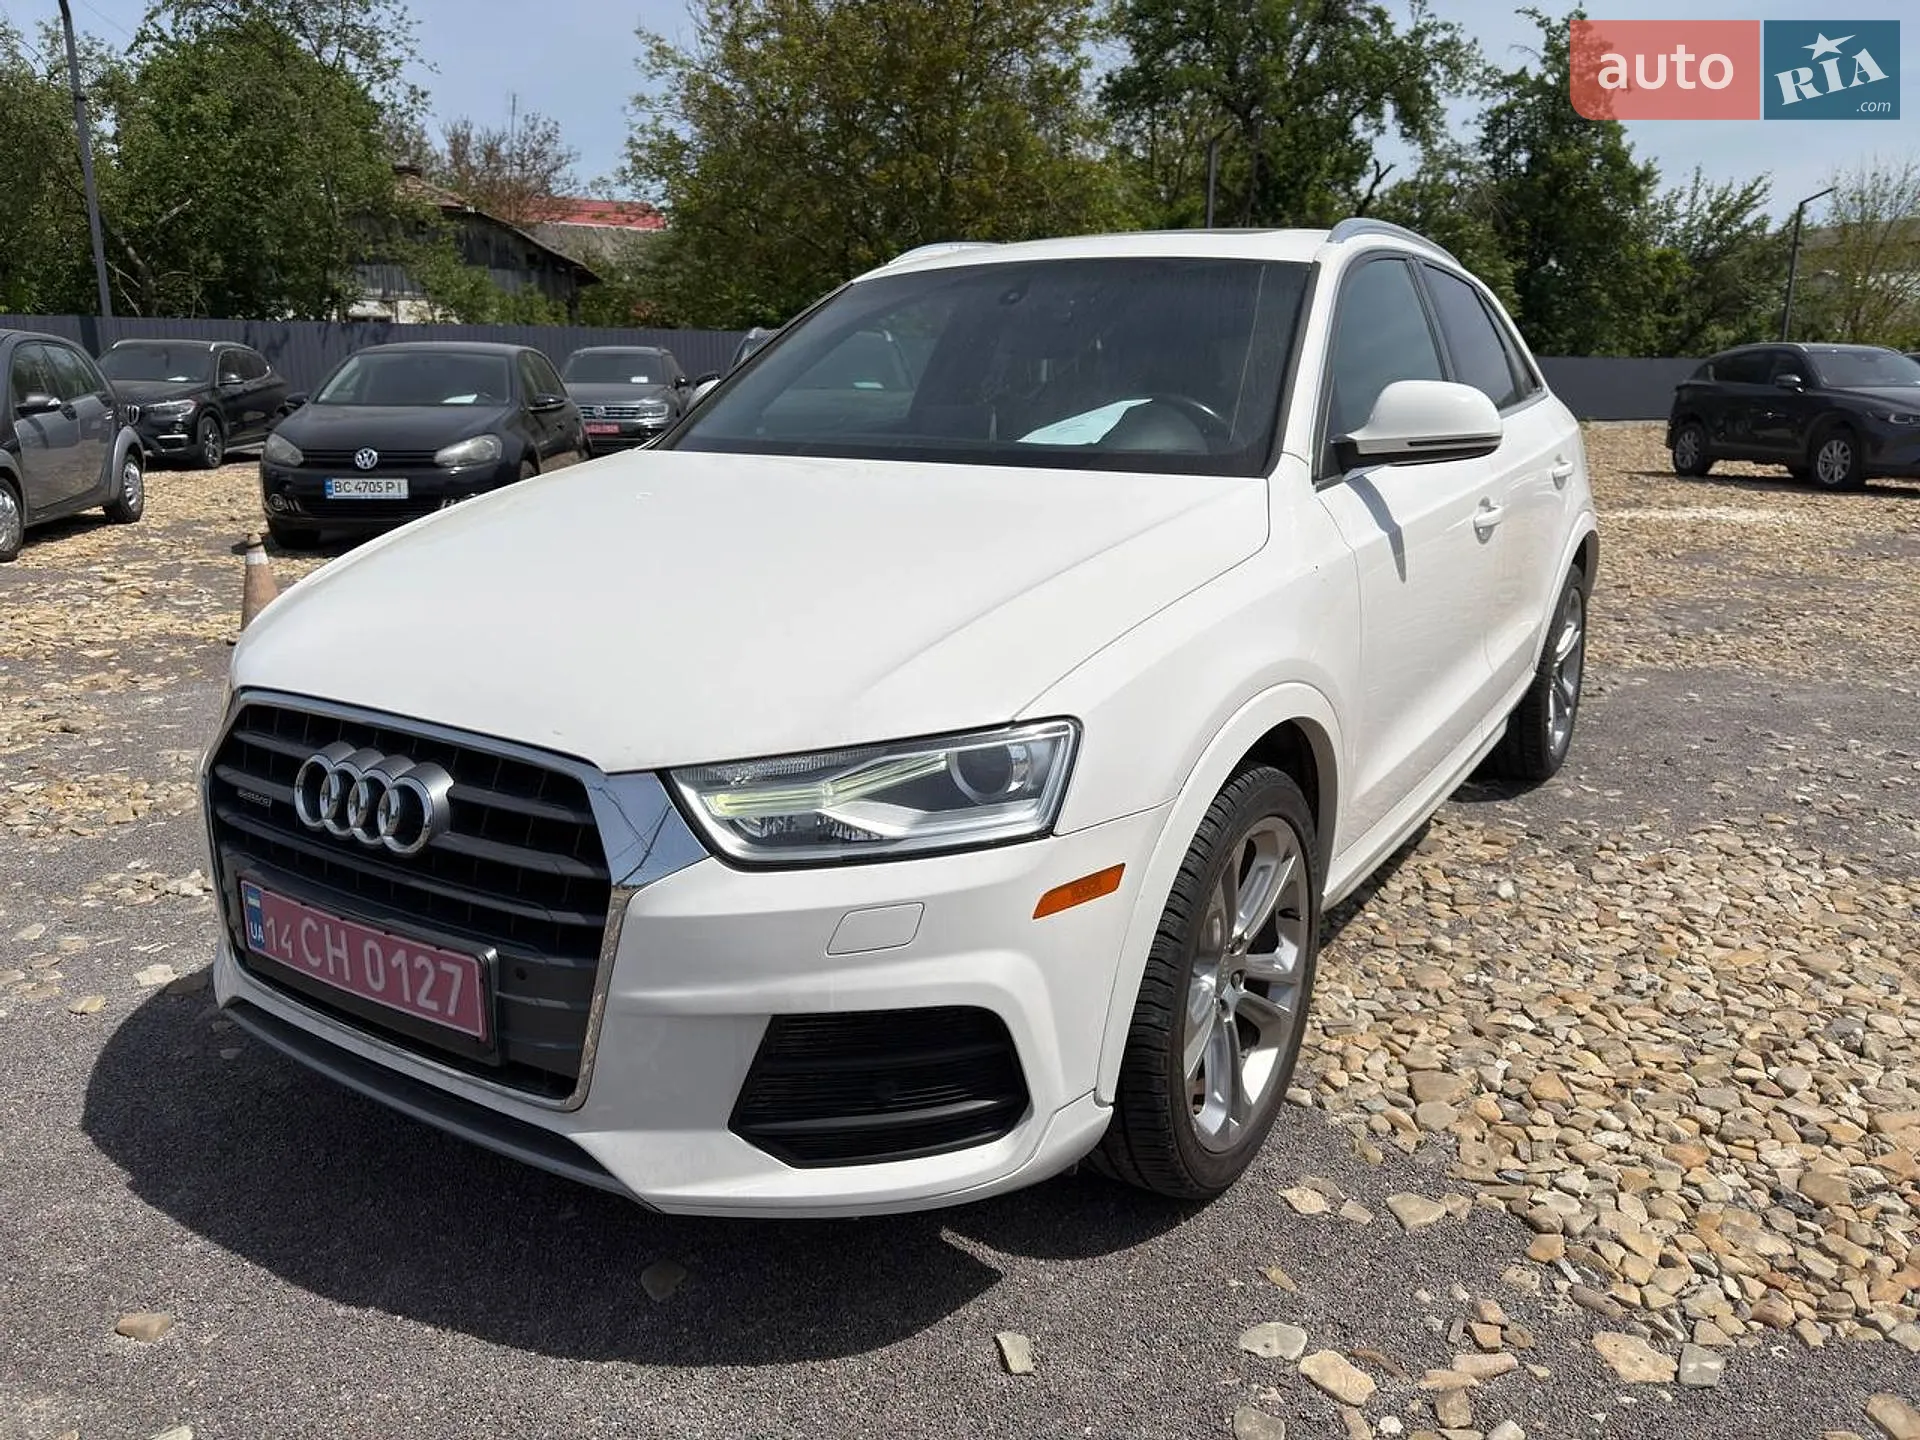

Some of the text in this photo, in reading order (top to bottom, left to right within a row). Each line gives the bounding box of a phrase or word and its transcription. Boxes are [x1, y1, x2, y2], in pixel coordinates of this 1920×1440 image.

[334, 481, 402, 493] BC 4705 PI
[250, 922, 265, 943] UA
[266, 917, 463, 1017] 14 CH 0127
